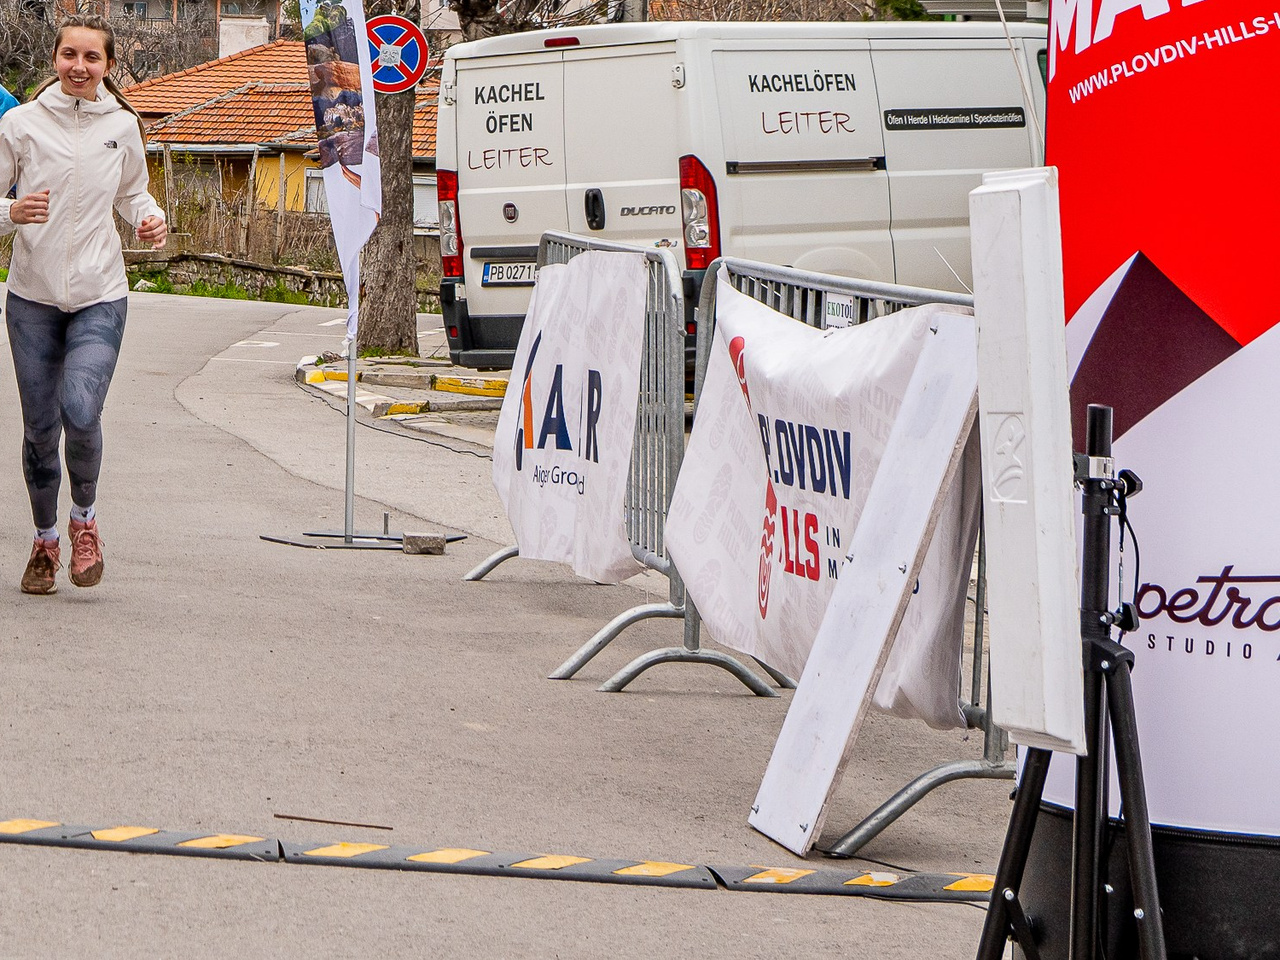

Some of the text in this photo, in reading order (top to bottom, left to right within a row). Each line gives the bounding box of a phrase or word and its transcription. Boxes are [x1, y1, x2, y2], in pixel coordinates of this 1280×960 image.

[474, 82, 545, 105] KACHEL
[748, 72, 857, 93] KACHELÖFEN
[485, 111, 533, 134] ÖFEN
[762, 110, 856, 135] LEITER
[887, 114, 903, 125] Öfen
[908, 115, 928, 125] Herde
[932, 113, 970, 124] Heizkamine
[974, 113, 1023, 125] Specksteinöfen
[467, 146, 554, 171] LEITER
[620, 205, 676, 217] DUCATO
[489, 265, 504, 280] PB
[506, 264, 531, 280] 0271
[778, 505, 821, 582] LLS
[826, 525, 841, 549] IN
[1147, 633, 1252, 660] STUDIO
